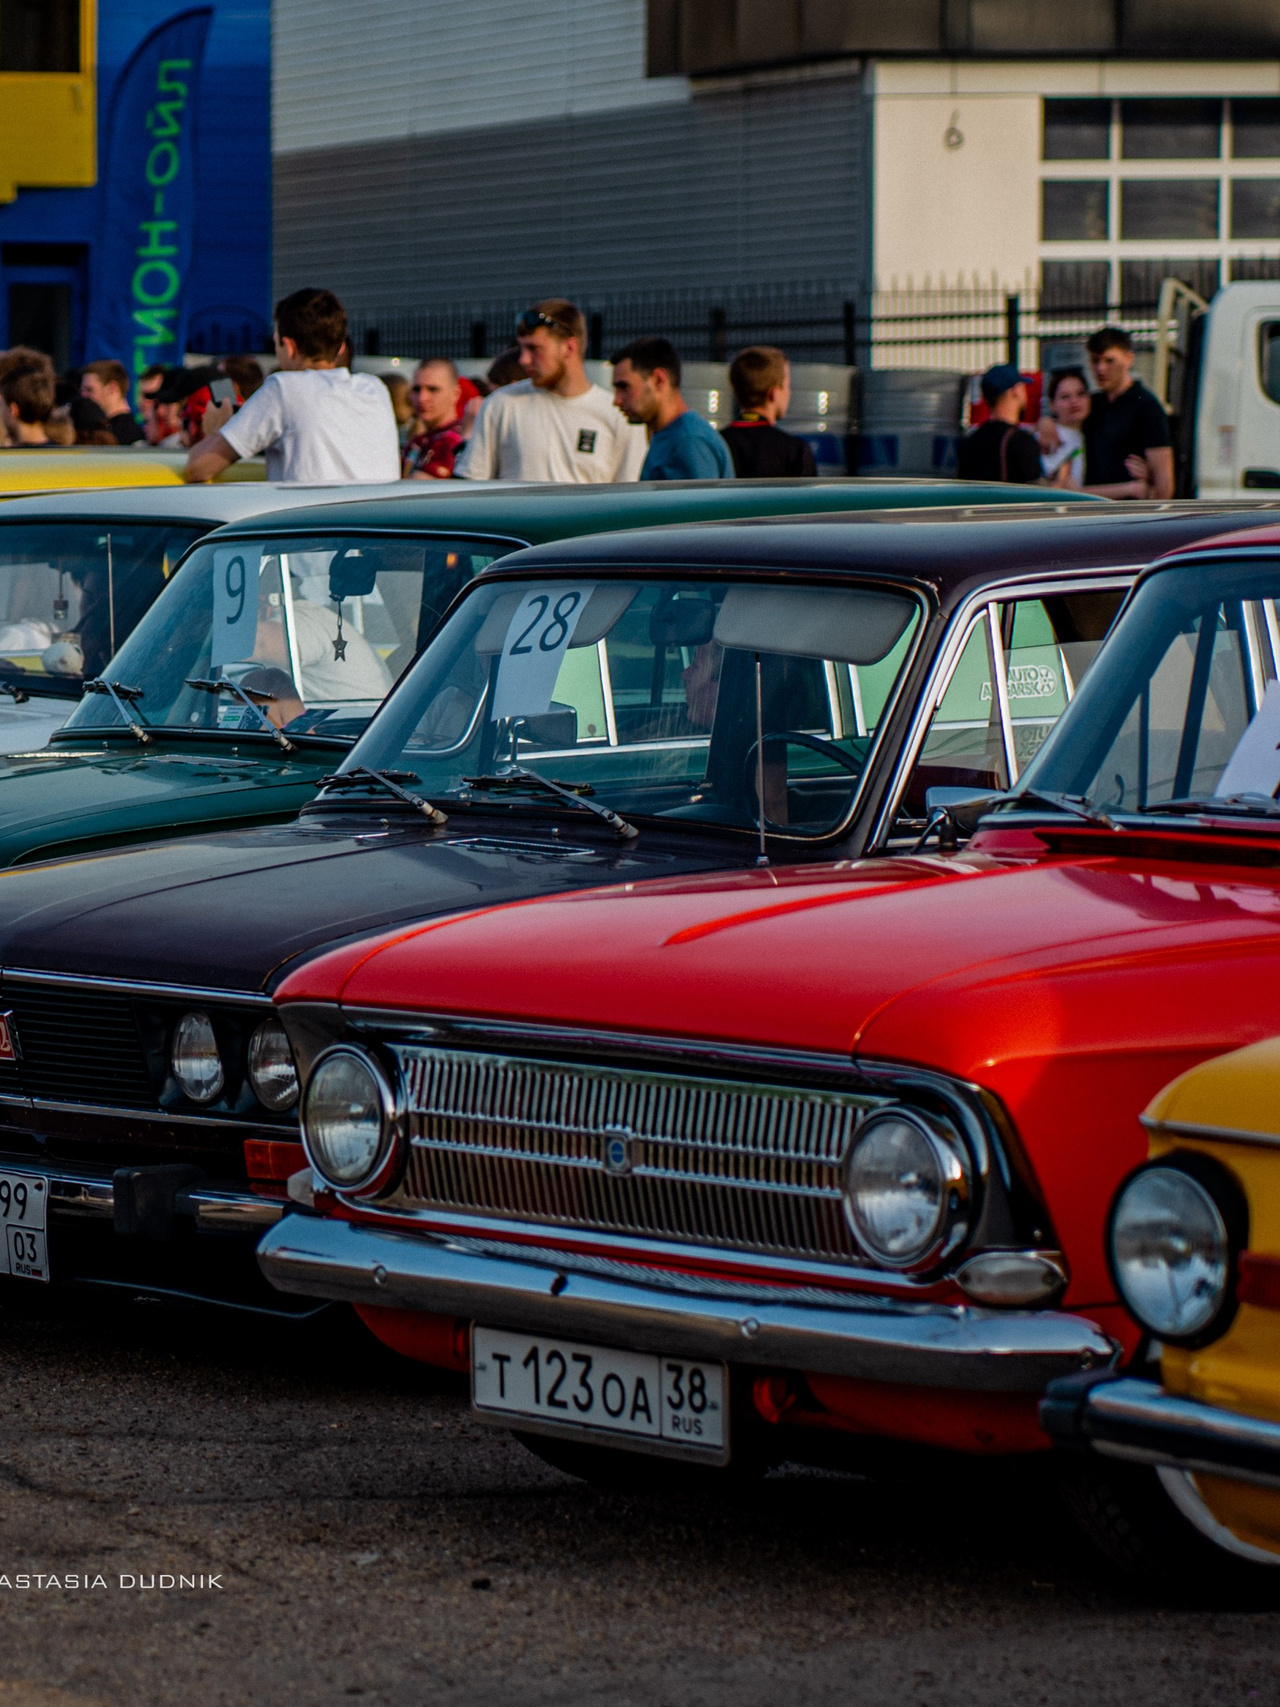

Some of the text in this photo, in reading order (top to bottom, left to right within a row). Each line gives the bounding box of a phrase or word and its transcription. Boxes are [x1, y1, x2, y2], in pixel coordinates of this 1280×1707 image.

[225, 555, 246, 625] 9
[509, 591, 582, 656] 28
[981, 681, 1041, 699] AARSK
[14, 1231, 37, 1263] 03
[16, 1262, 32, 1276] RUS
[666, 1363, 708, 1414] 38
[671, 1414, 703, 1435] RUS
